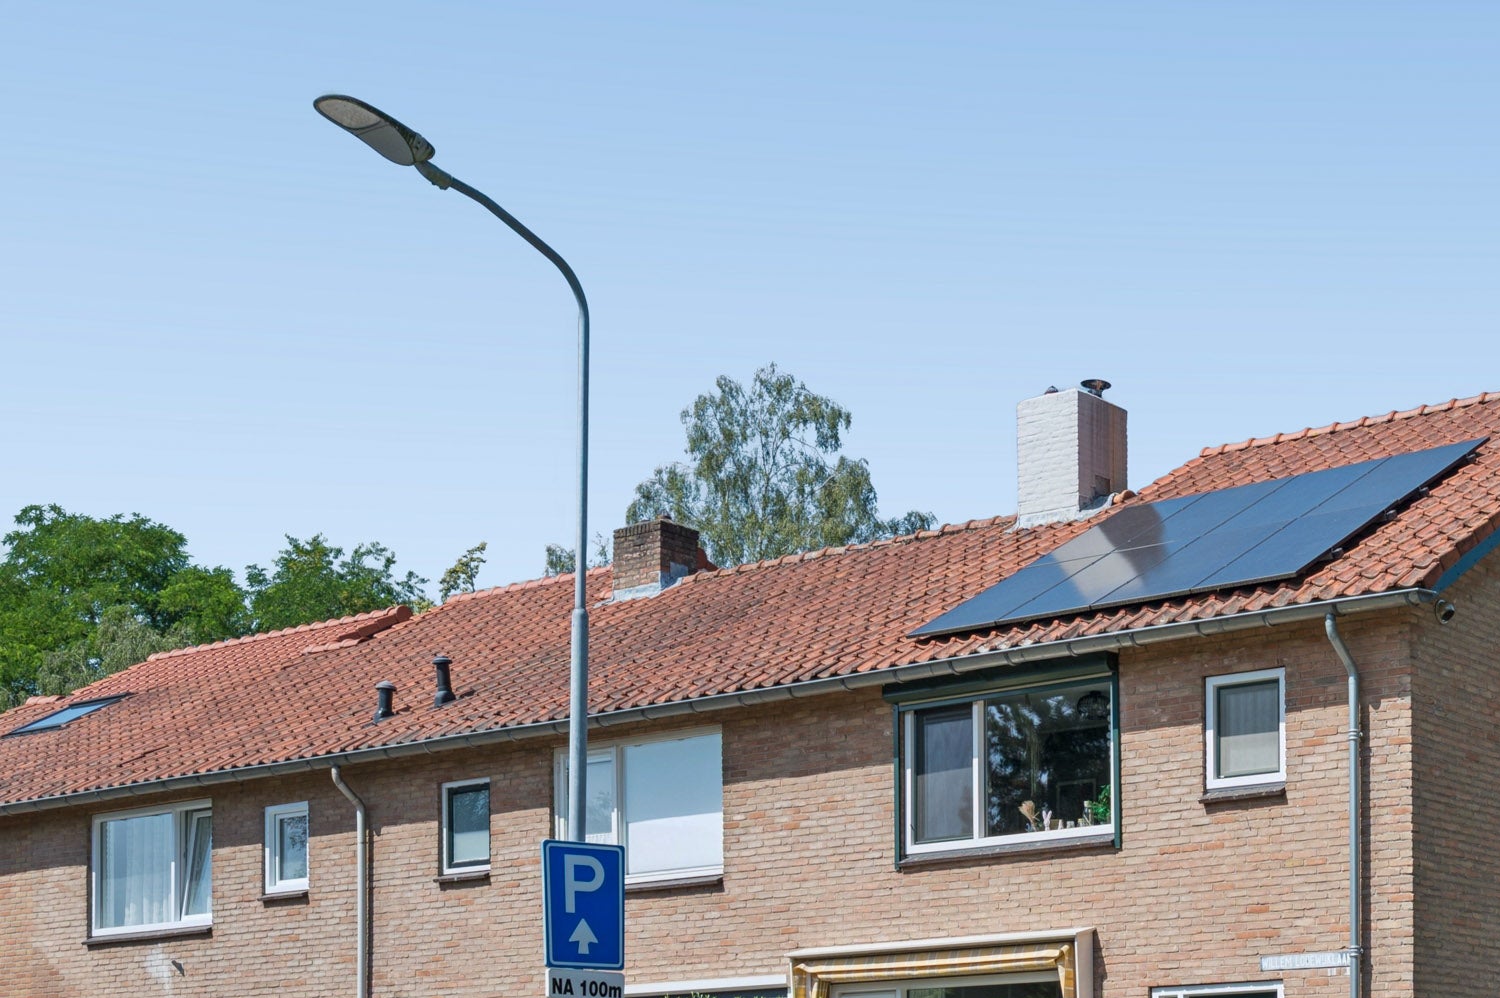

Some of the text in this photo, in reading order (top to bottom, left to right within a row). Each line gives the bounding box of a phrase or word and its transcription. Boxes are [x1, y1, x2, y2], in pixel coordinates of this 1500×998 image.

[564, 854, 605, 914] P
[1262, 955, 1292, 970] WILLEM
[552, 977, 622, 998] NA 100m
